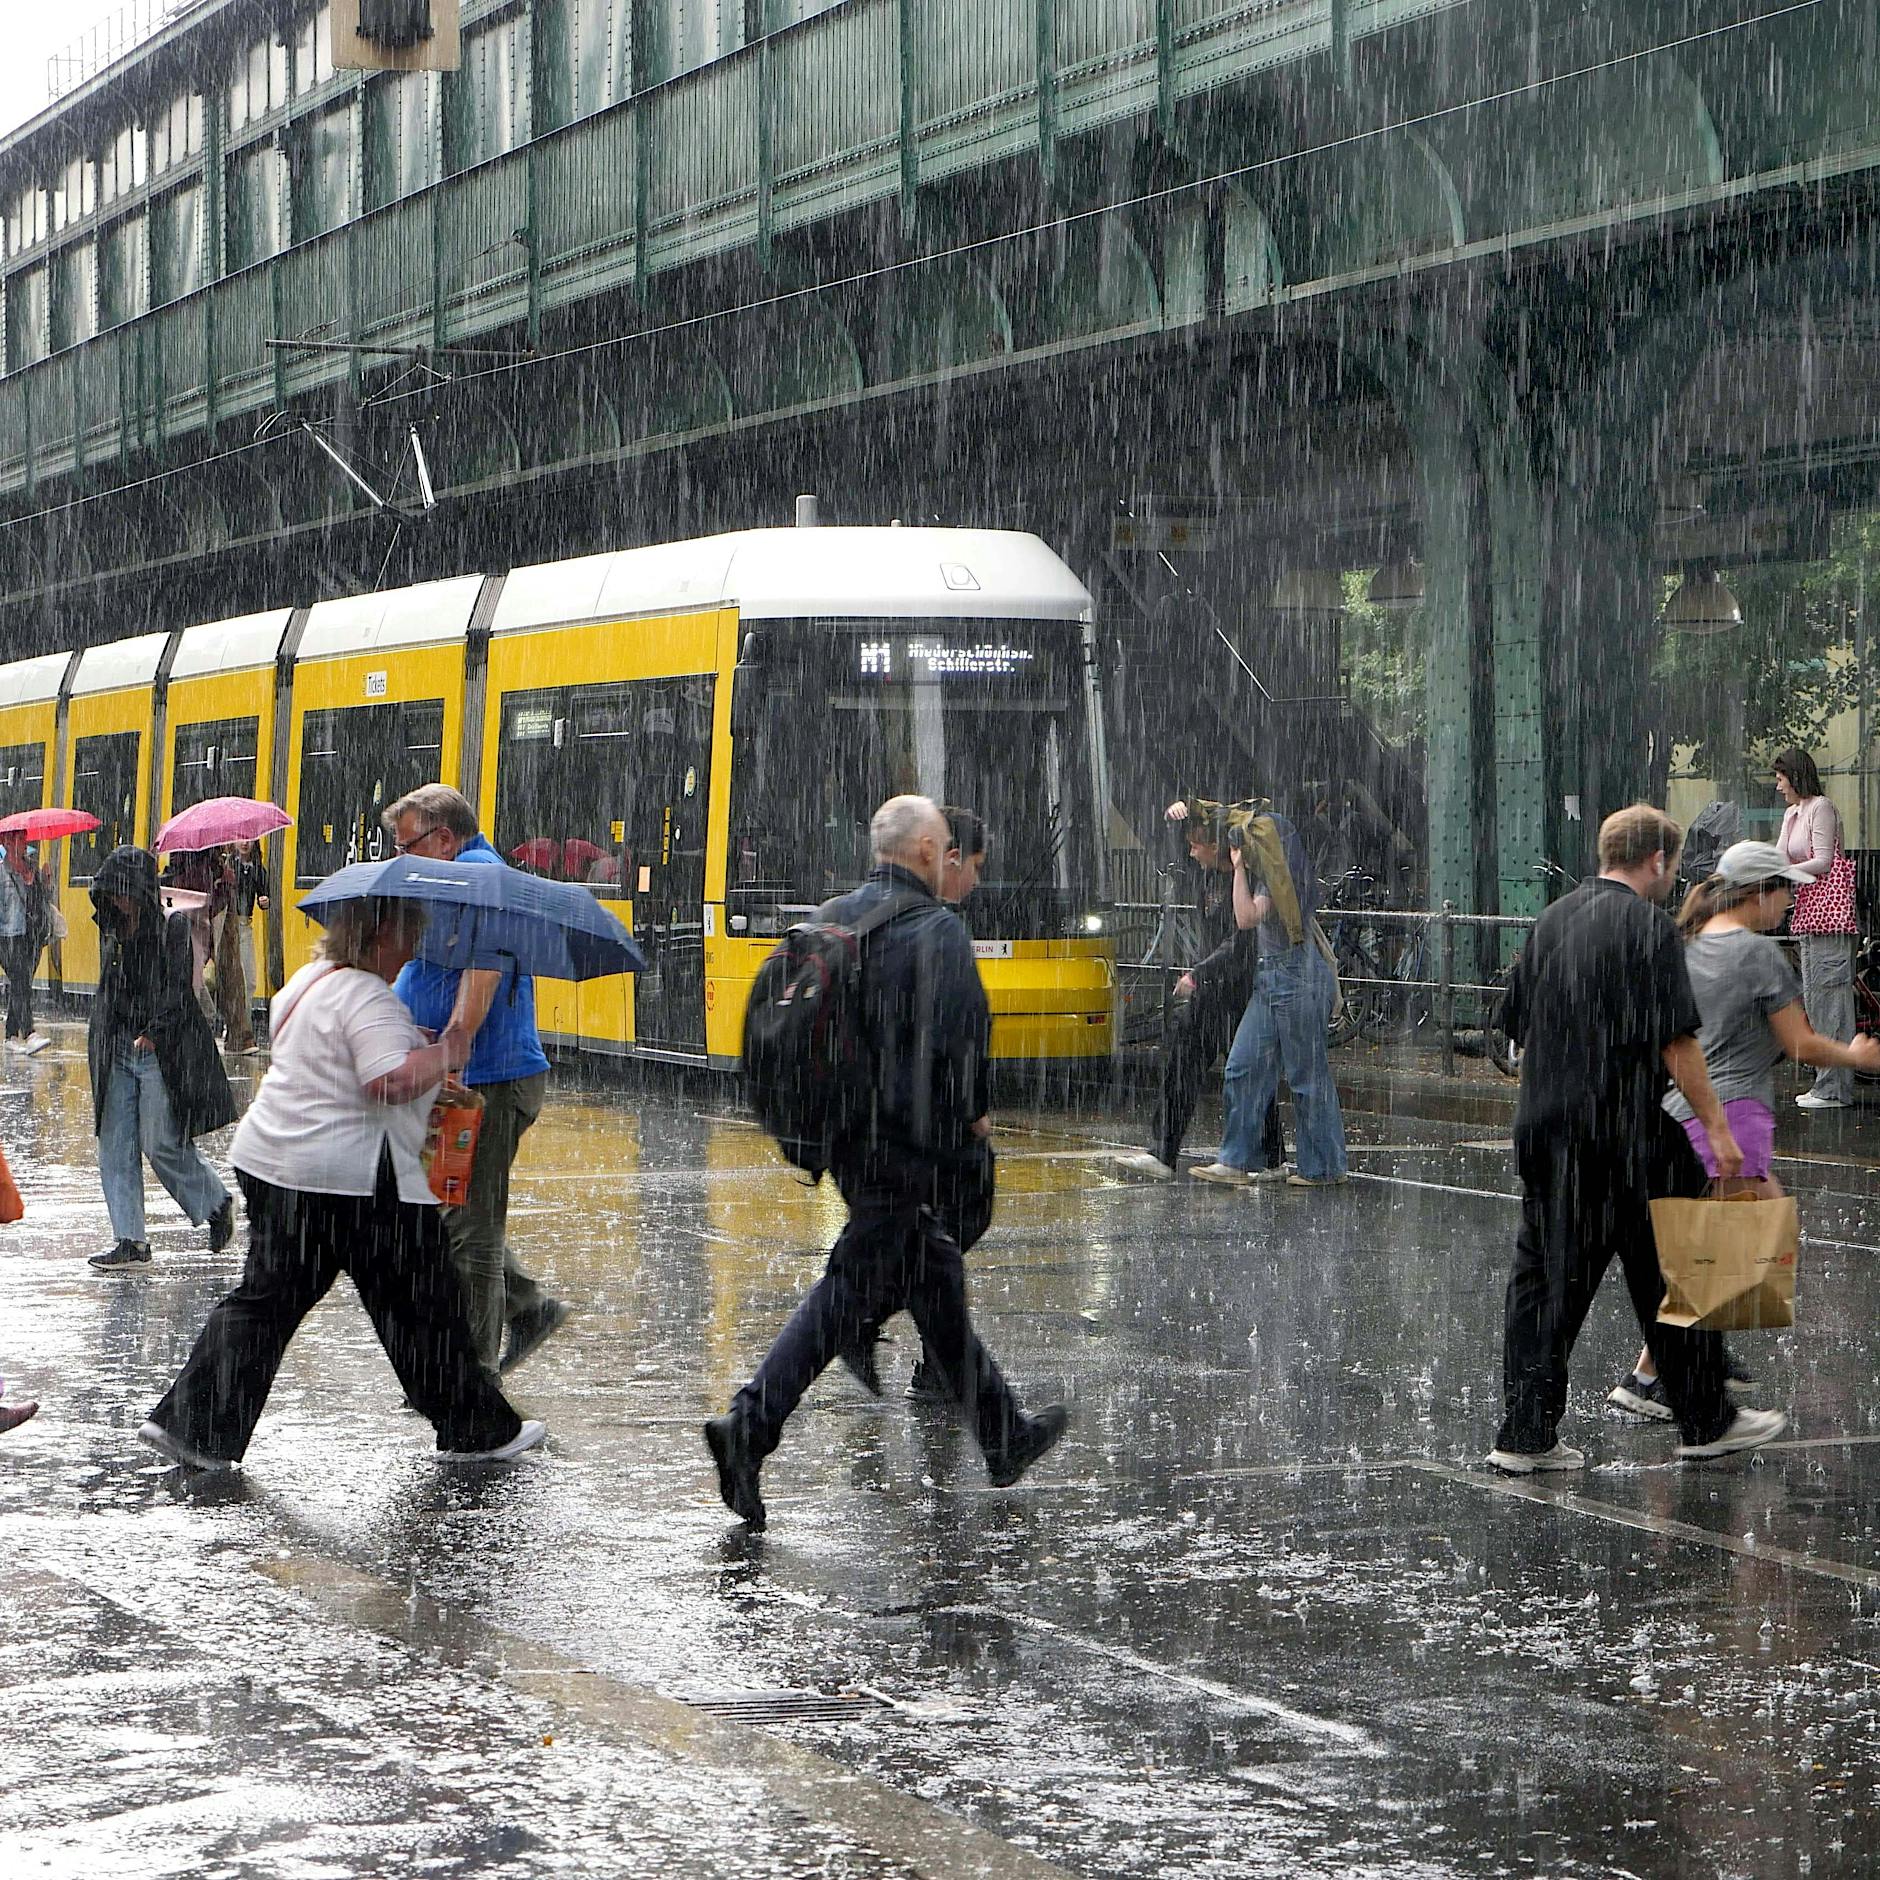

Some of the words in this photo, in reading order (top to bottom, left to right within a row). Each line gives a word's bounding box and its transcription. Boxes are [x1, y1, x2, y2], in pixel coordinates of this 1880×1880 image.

[861, 643, 891, 673] M1
[927, 657, 1016, 673] Schillerstr.
[368, 674, 385, 694] Tickets
[972, 945, 994, 953] ERLIN
